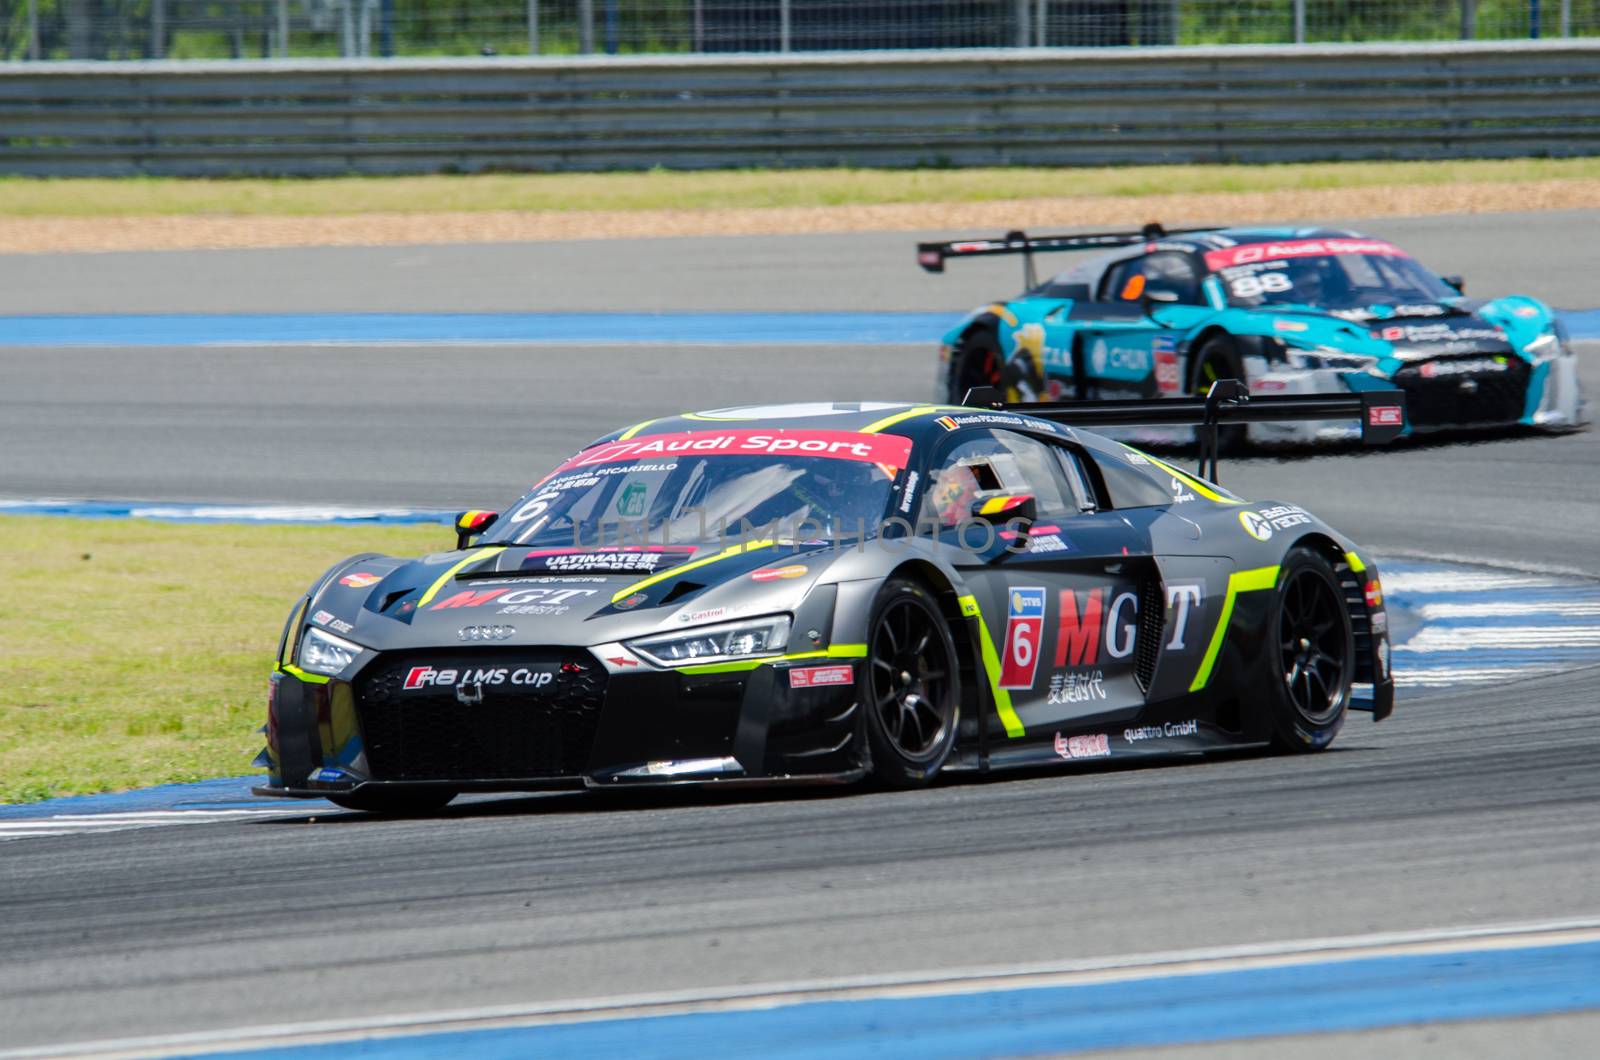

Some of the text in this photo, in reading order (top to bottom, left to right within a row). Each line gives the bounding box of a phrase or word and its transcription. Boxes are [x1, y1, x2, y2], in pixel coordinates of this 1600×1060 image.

[1231, 273, 1293, 298] 88
[632, 435, 873, 456] Audi Sport
[595, 463, 679, 477] PICARIELLO
[510, 491, 561, 524] 6
[546, 554, 642, 566] ULTIMATE
[690, 608, 723, 621] Castrol
[1012, 623, 1033, 667] 6
[415, 668, 553, 688] R8 LMS Cup
[1124, 719, 1199, 744] quattro GmbH
